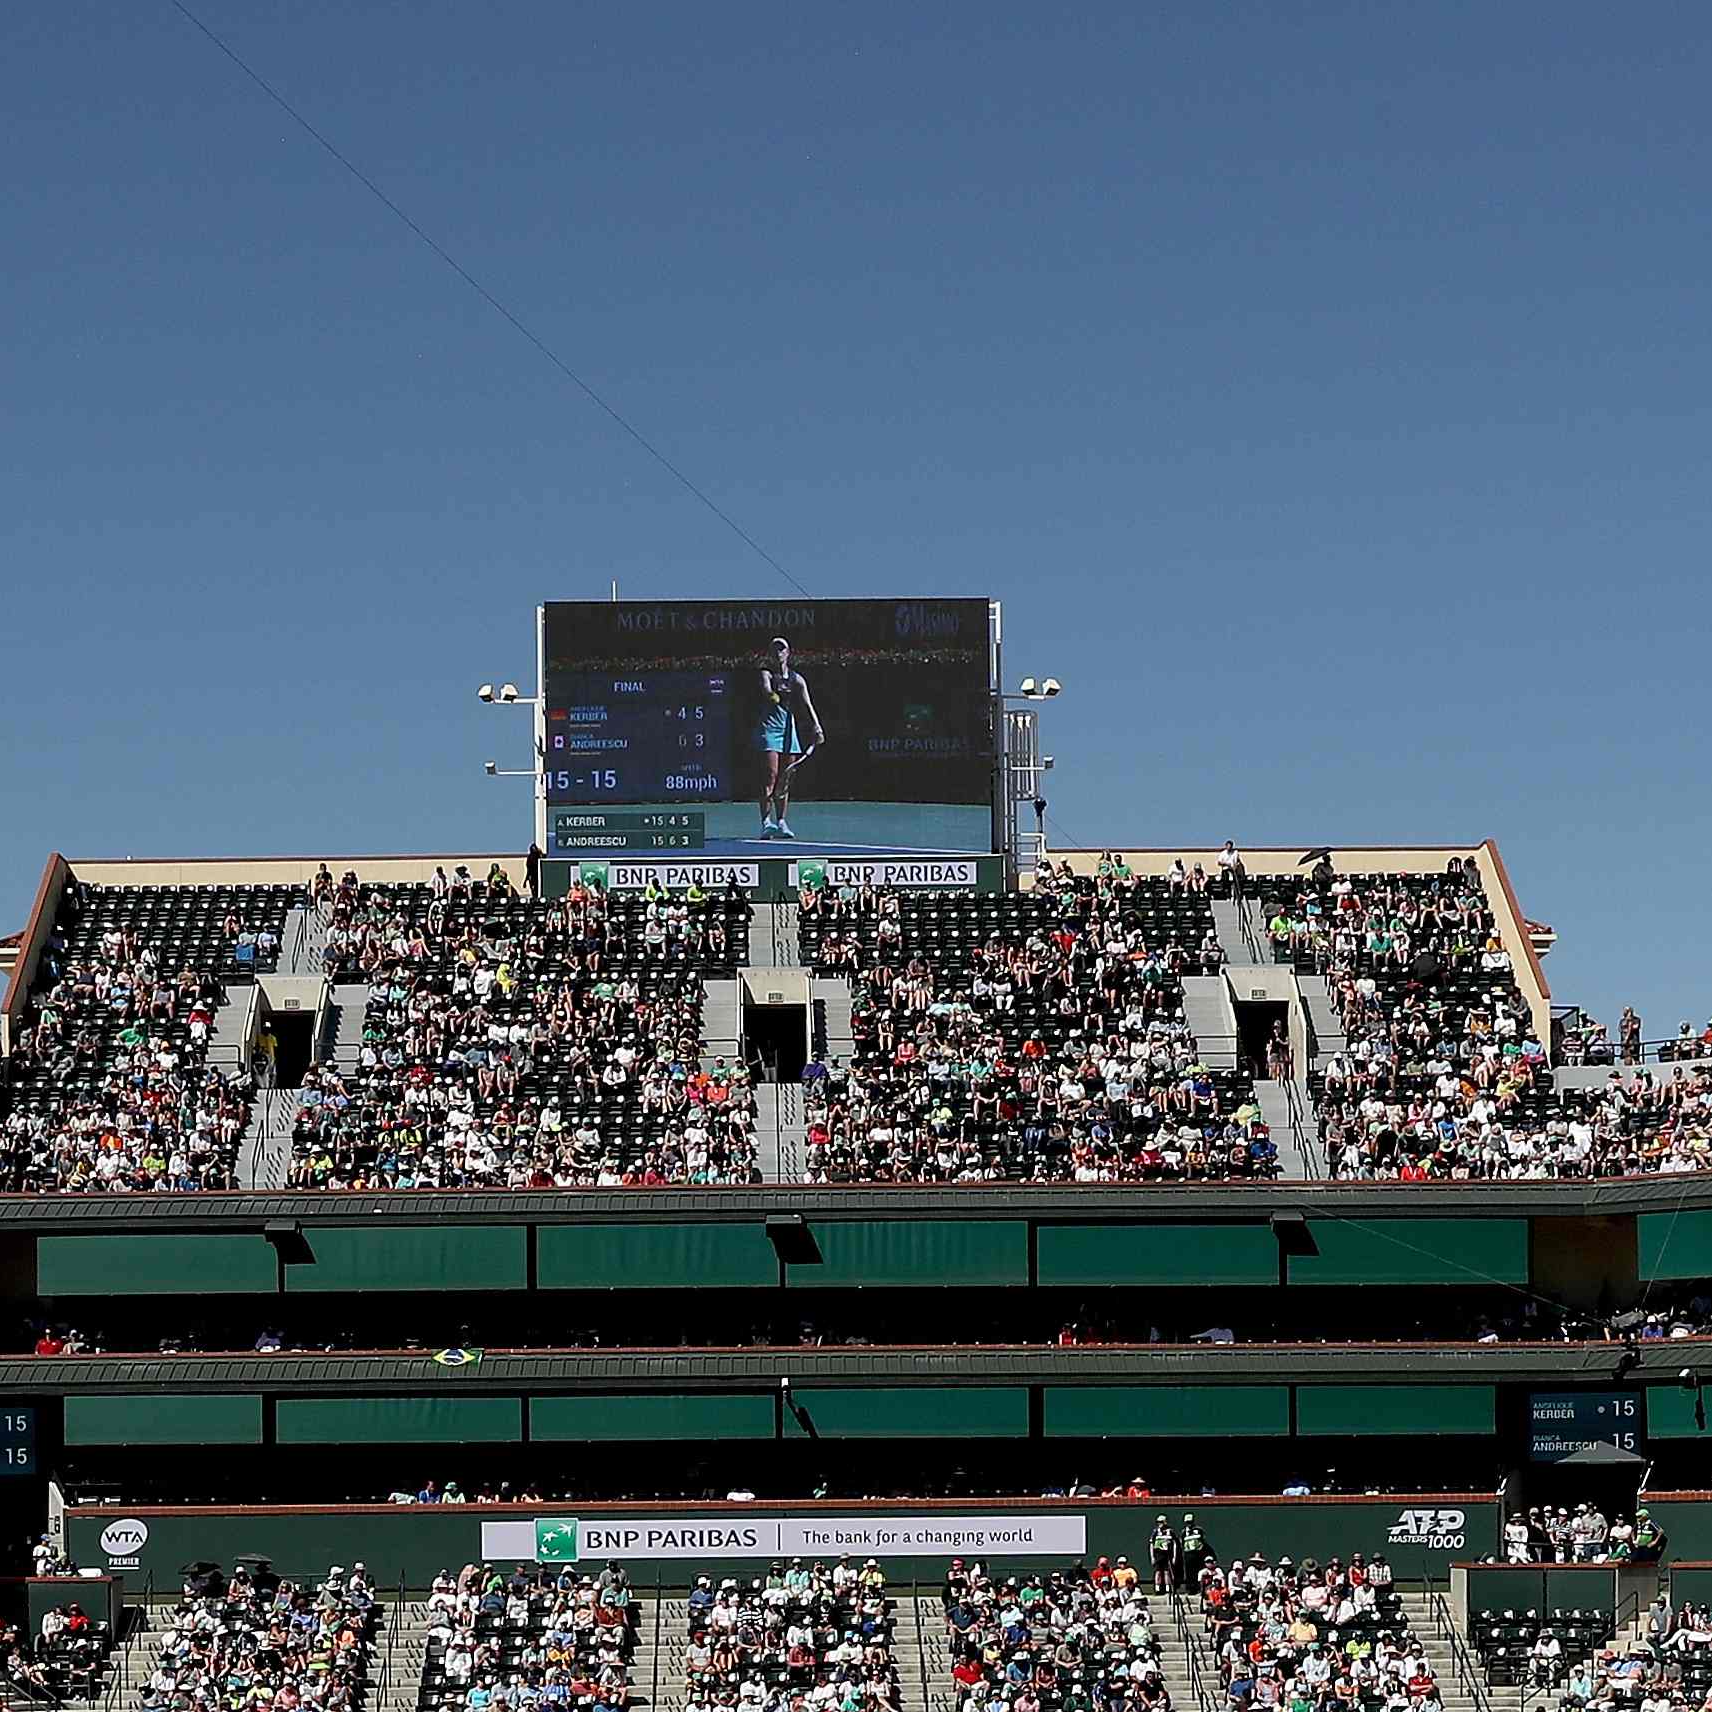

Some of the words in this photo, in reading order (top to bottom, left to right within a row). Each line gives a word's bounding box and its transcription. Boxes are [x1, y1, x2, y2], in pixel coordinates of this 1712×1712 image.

[703, 608, 816, 631] CHANDON
[614, 681, 646, 692] FINAL
[678, 707, 686, 719] 4
[695, 707, 704, 719] 5
[695, 734, 704, 746] 3
[592, 770, 616, 789] 15
[666, 775, 718, 791] 88mph
[566, 817, 606, 827] KERBER
[652, 816, 663, 826] 15
[669, 816, 676, 826] 4
[682, 816, 689, 826] 5
[566, 836, 627, 847] ANDREESCU
[652, 836, 664, 847] 15
[669, 836, 676, 846] 6
[682, 836, 689, 846] 3
[616, 868, 657, 884] BNP
[666, 866, 751, 884] PARIBAS
[834, 865, 875, 882] BNP
[887, 864, 968, 882] PARIBAS
[1612, 1400, 1634, 1416] 15
[5, 1415, 27, 1431] 15
[1533, 1441, 1597, 1451] ANDREESCU
[1612, 1433, 1634, 1449] 15
[5, 1448, 27, 1464] 15
[1387, 1510, 1466, 1535] ATP
[104, 1531, 145, 1544] WTA
[586, 1530, 641, 1549] BNP
[647, 1528, 758, 1548] PARIBAS
[802, 1530, 830, 1545] The
[834, 1530, 871, 1545] bank
[874, 1529, 897, 1547] for
[903, 1533, 912, 1544] a
[915, 1529, 981, 1548] changing
[985, 1528, 1034, 1543] world
[1388, 1534, 1428, 1545] MASTERS
[1427, 1534, 1466, 1549] 1000
[108, 1557, 140, 1566] PREMIER
